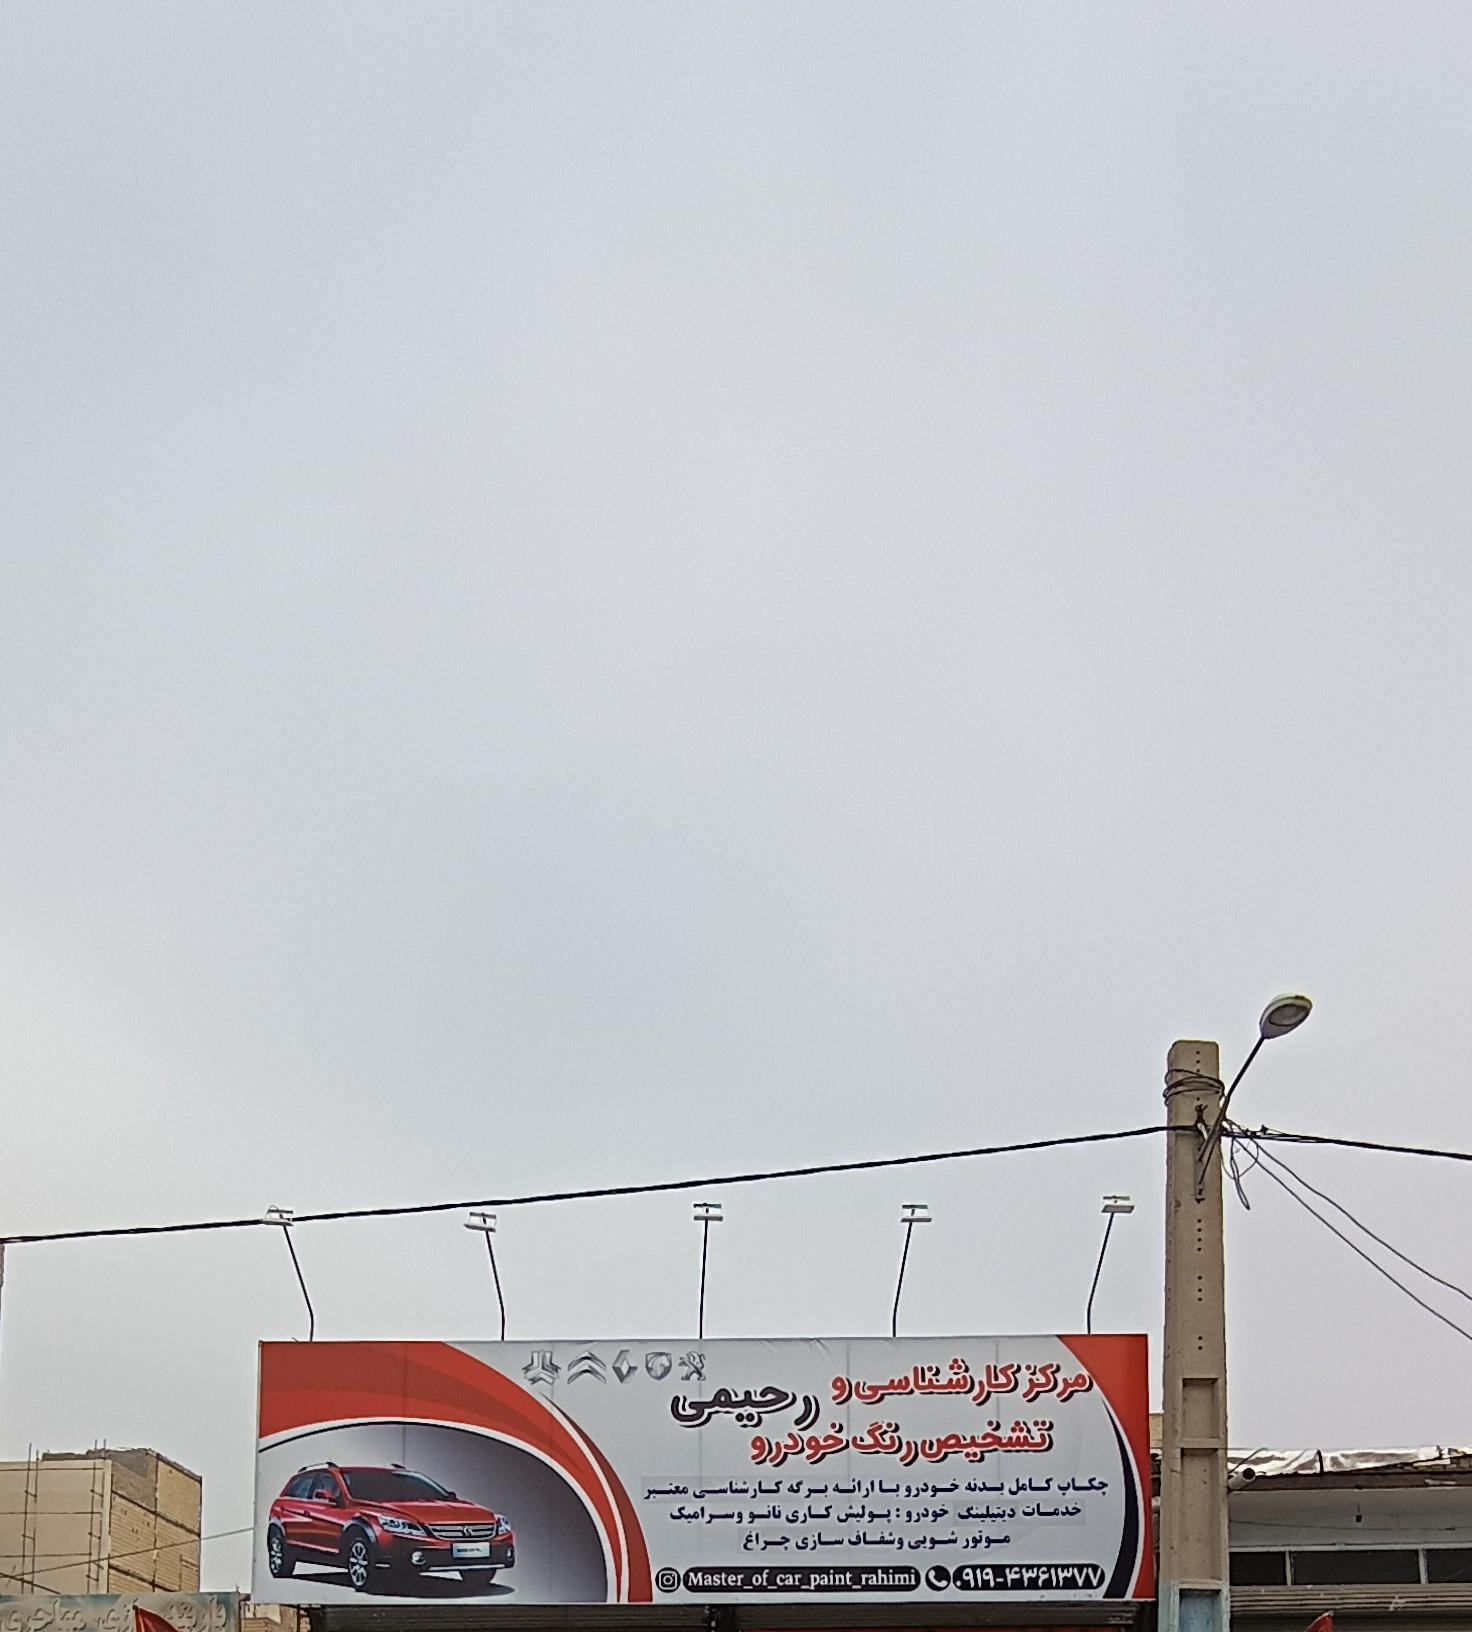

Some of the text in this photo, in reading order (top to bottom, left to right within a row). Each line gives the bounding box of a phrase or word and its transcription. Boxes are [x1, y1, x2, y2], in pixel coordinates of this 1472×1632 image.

[831, 1358, 1093, 1404] مرکز کارشناسی و
[671, 1383, 819, 1431] رحیمی
[751, 1418, 1052, 1466] تشخیص رنگ خودرو
[644, 1482, 689, 1500] معتبر
[693, 1479, 782, 1498] کارشناسی
[832, 1479, 875, 1498] ارائه
[879, 1479, 900, 1496] با
[903, 1478, 959, 1497] خودرو
[965, 1478, 1004, 1495] بدنه
[1008, 1477, 1053, 1495] کامل
[1057, 1476, 1109, 1496] چکاپ
[748, 1505, 781, 1523] نانو
[786, 1505, 832, 1523] کاری
[837, 1504, 891, 1524] پولیش
[905, 1503, 949, 1523] خودرو
[1022, 1502, 1081, 1517] خدمات
[743, 1531, 790, 1551] چراغ
[796, 1532, 844, 1550] سازی
[908, 1531, 958, 1549] شویی
[963, 1529, 1011, 1548] موتور
[688, 1568, 916, 1591] Master_of_car_paint_rahimi
